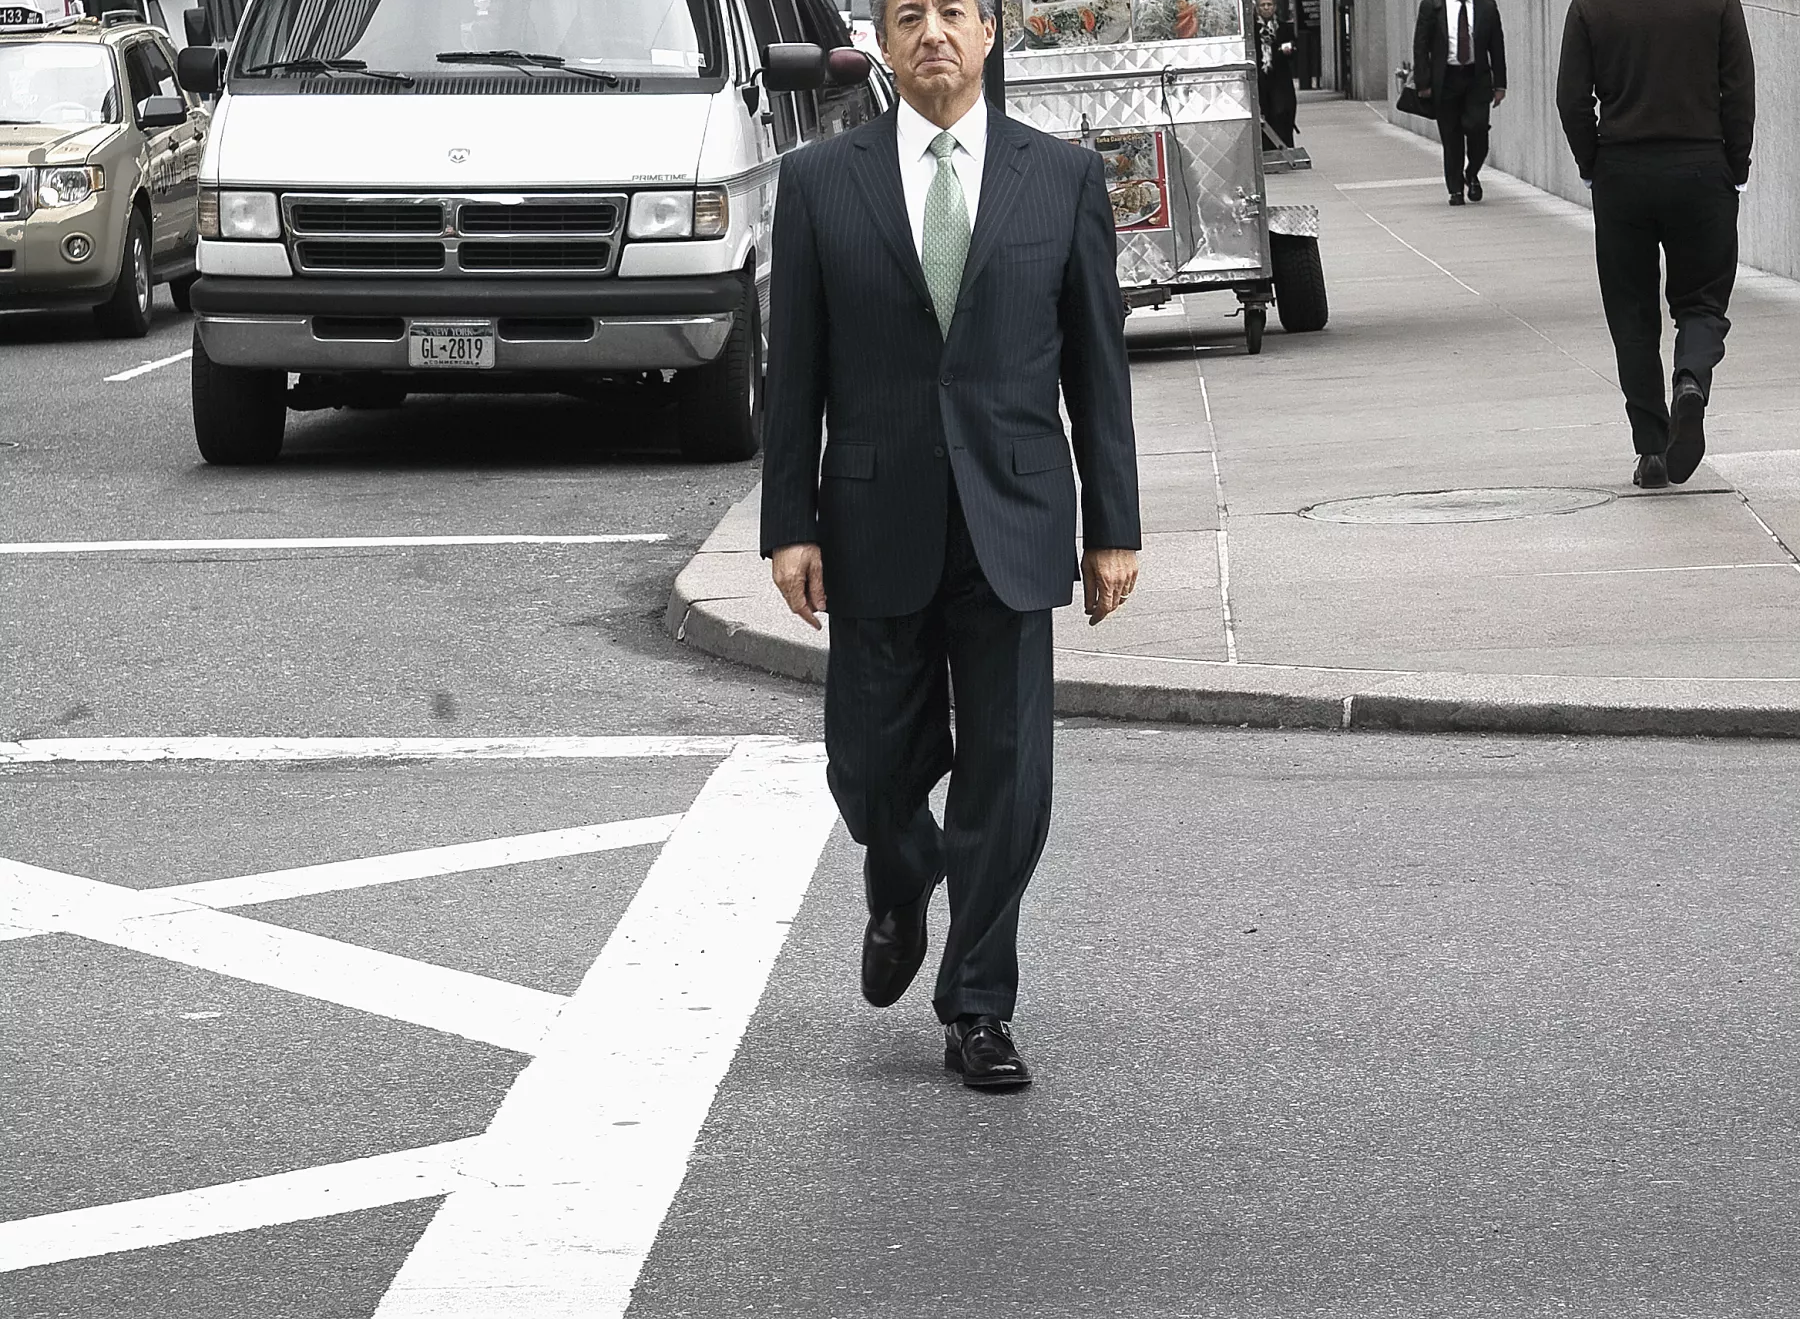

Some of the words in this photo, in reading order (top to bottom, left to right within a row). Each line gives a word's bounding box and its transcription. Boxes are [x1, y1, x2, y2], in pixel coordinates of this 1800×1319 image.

[429, 327, 449, 336] NEW
[450, 327, 475, 336] YORK
[421, 338, 438, 359] GL
[449, 338, 483, 359] 2819
